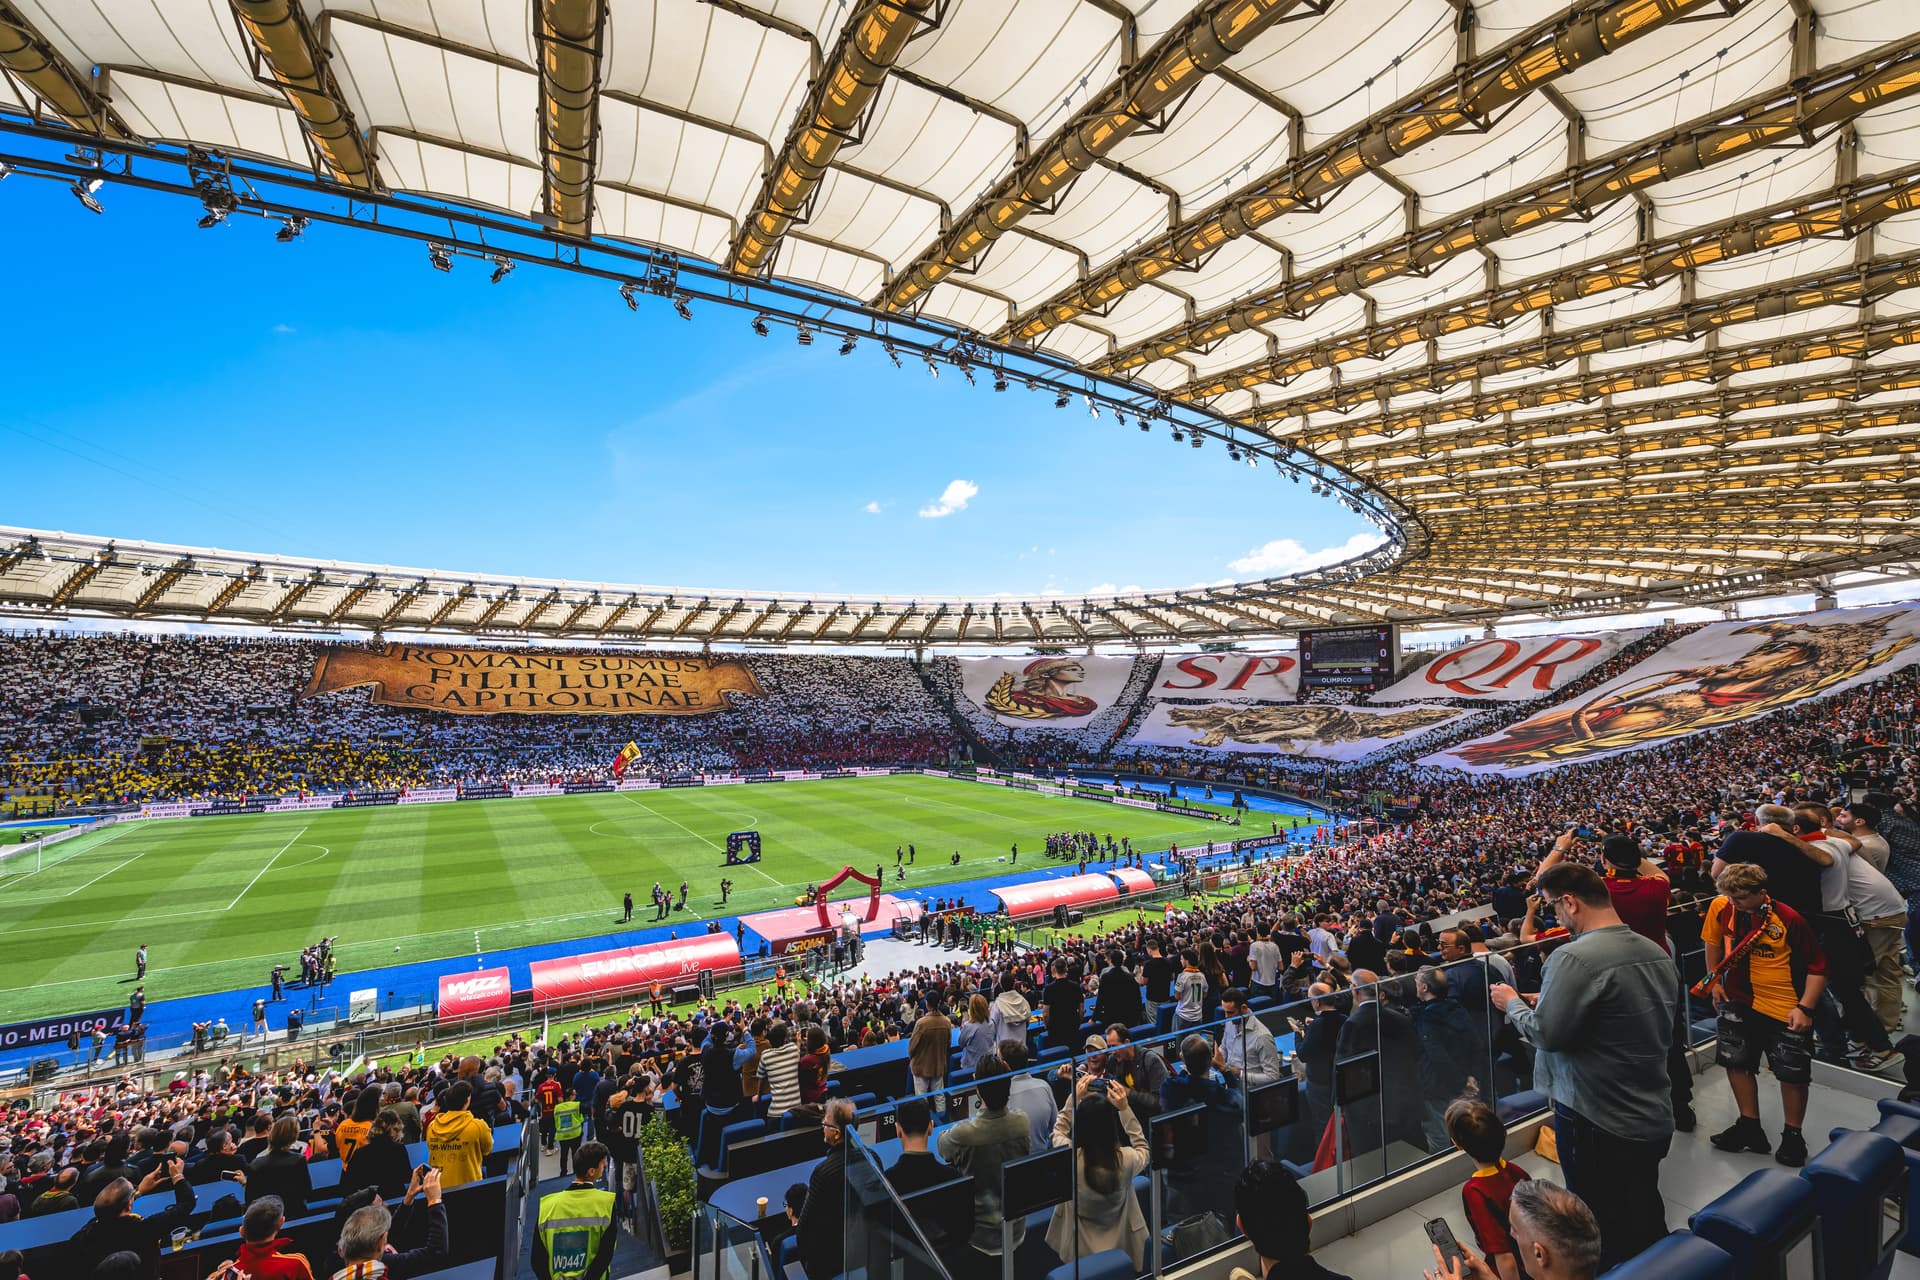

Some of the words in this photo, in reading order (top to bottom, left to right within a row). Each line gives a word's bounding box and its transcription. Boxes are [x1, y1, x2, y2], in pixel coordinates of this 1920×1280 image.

[400, 647, 565, 671] ROMANI
[578, 657, 701, 673] SUMUS
[1304, 651, 1311, 660] 0
[1380, 648, 1387, 657] 0
[1162, 655, 1297, 691] SP
[1425, 638, 1602, 695] QR
[430, 668, 537, 690] FILII
[559, 672, 682, 689] LUPAE
[405, 684, 703, 708] CAPITOLINAE
[1676, 852, 1684, 863] 4
[447, 976, 503, 996] WIZZ
[1191, 983, 1202, 1003] 11
[1167, 1041, 1176, 1049] 35
[544, 1091, 553, 1104] 11
[953, 1097, 963, 1107] 37
[623, 1111, 643, 1139] 01
[883, 1115, 895, 1125] 38
[344, 1138, 357, 1162] 7
